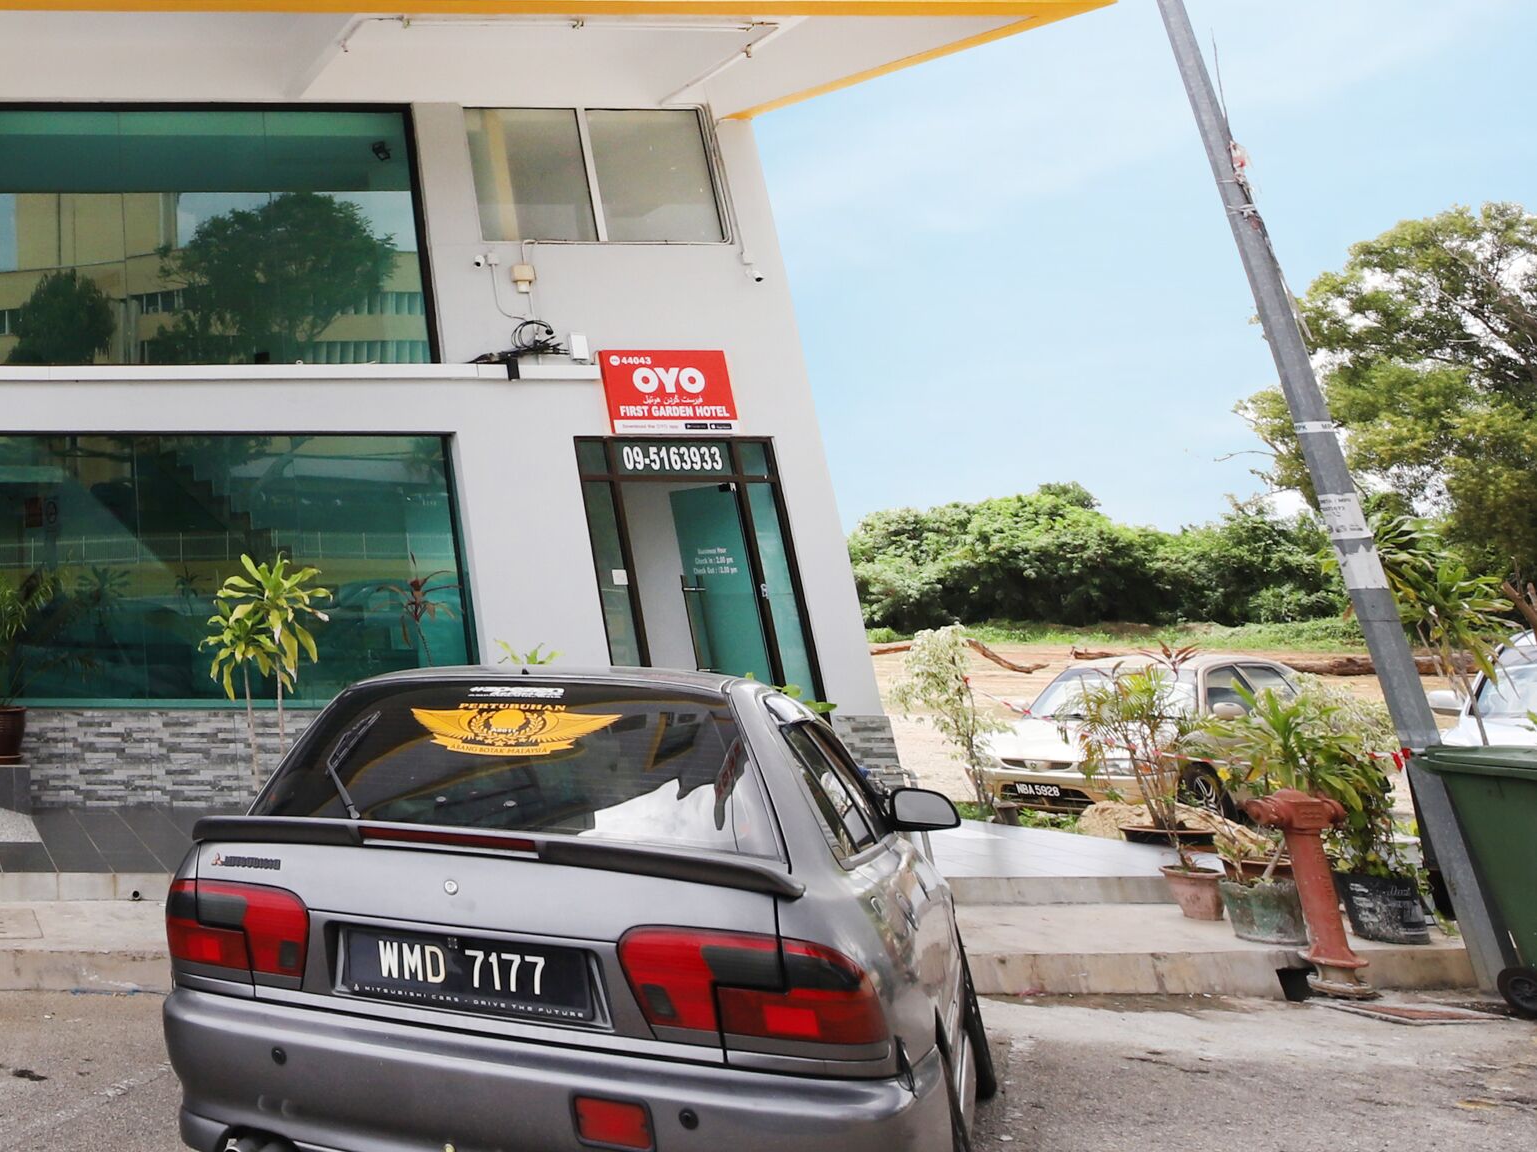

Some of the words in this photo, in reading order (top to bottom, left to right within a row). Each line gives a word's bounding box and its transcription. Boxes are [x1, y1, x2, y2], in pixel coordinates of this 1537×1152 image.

[621, 356, 652, 365] 44043
[632, 366, 706, 394] OYO
[619, 405, 649, 417] FIRST
[651, 405, 694, 417] GARDEN
[695, 405, 730, 417] HOTEL
[623, 446, 723, 470] 09-5163933
[459, 703, 566, 711] PERTUBUHAN
[507, 746, 547, 754] MALAYSIA
[1016, 783, 1036, 796] NBA
[378, 940, 447, 984] WMD
[464, 949, 546, 996] 7177
[364, 985, 428, 999] MITSUBISHI
[431, 993, 460, 1003] CARS
[473, 999, 507, 1008] DRIVE
[511, 1003, 533, 1012] THE
[537, 1007, 584, 1018] FUTURE
